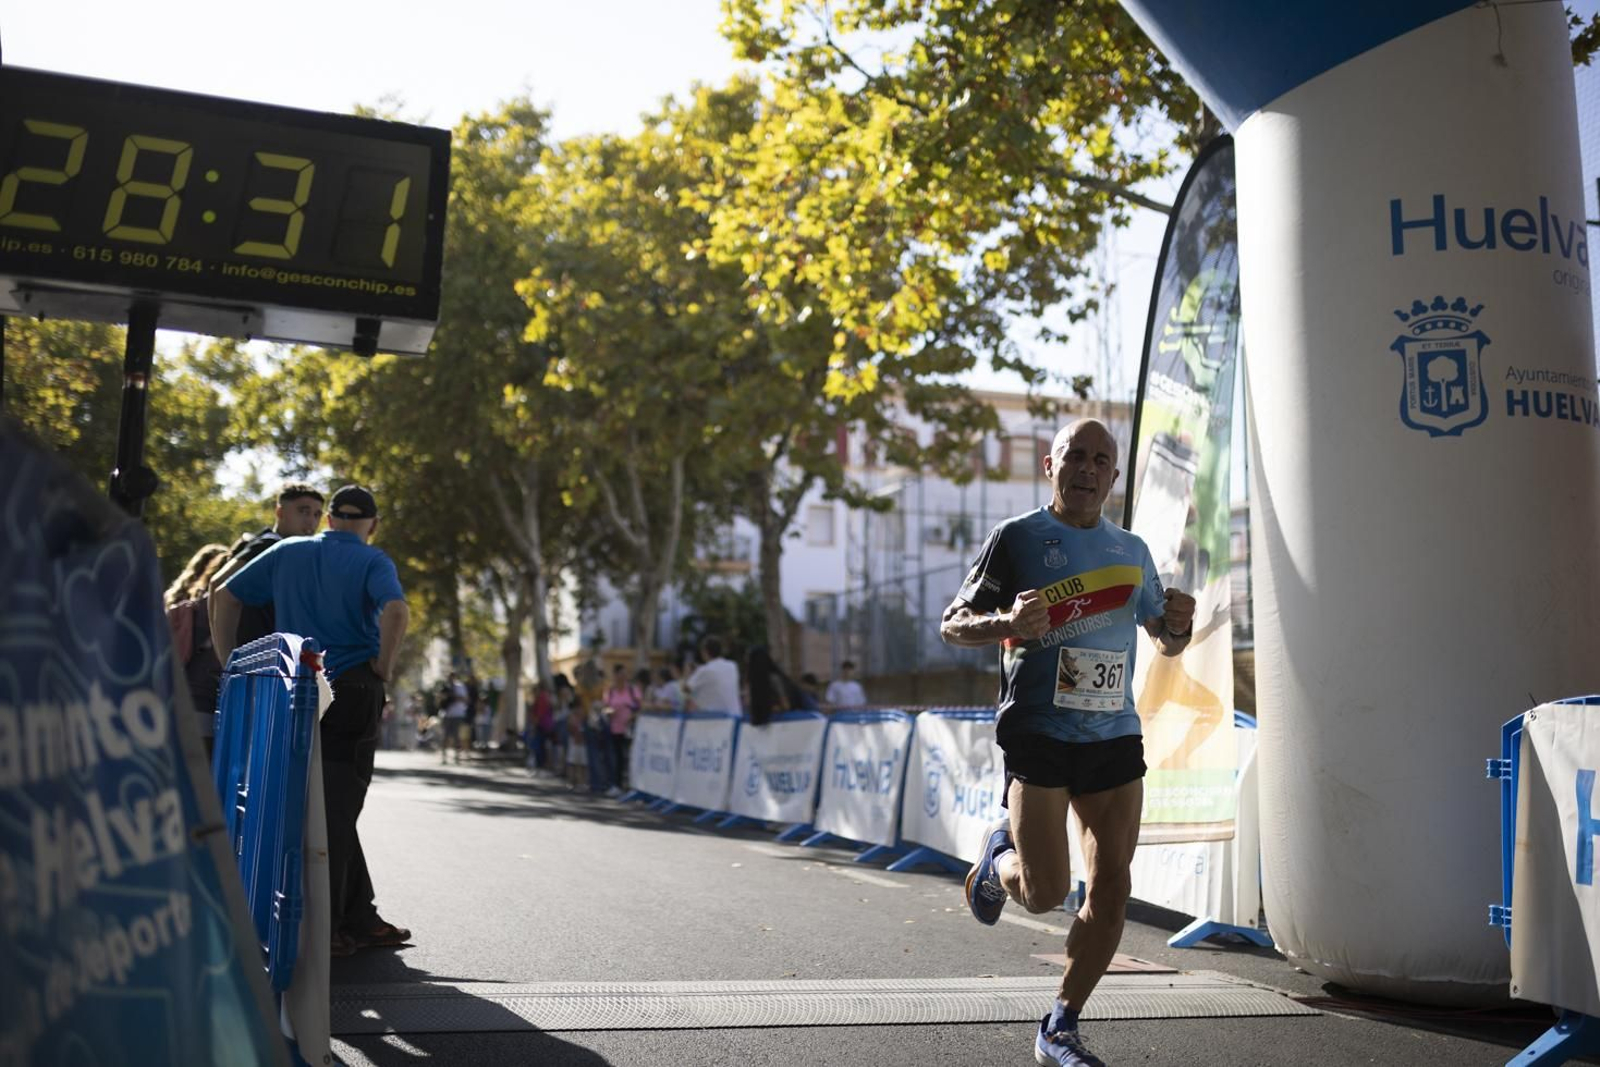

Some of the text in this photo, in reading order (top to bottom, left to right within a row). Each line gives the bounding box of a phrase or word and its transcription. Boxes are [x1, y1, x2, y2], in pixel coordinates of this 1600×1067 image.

[1390, 194, 1590, 271] Huelva
[73, 245, 113, 262] 615
[119, 250, 158, 269] 980
[165, 256, 202, 273] 784
[222, 261, 417, 297] info@gesconchip.es
[1506, 388, 1600, 427] HUELVA
[1044, 577, 1085, 605] CLUB
[1040, 612, 1113, 649] CONISTORSIS
[1092, 662, 1123, 689] 367
